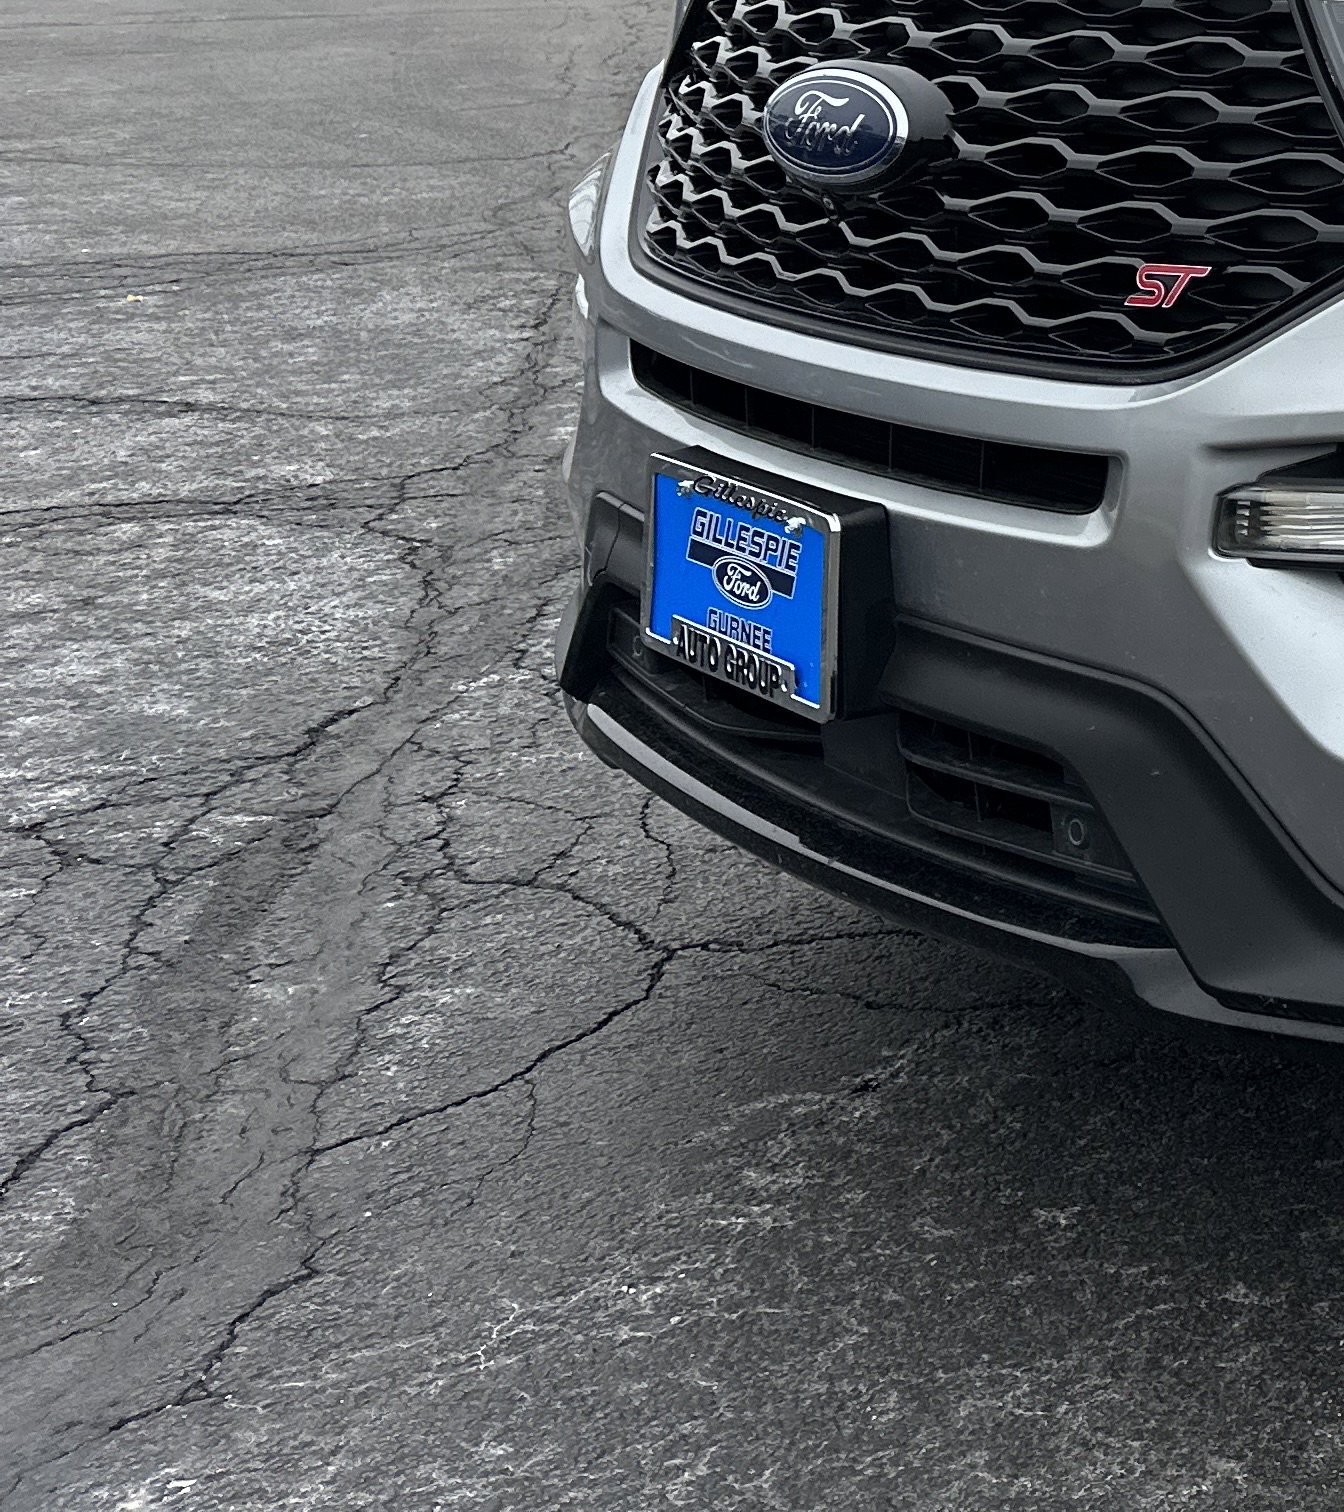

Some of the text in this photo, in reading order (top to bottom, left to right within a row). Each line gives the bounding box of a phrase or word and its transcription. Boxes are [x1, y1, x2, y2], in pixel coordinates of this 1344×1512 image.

[781, 88, 859, 155] Ford
[1123, 263, 1212, 309] ST
[693, 474, 789, 523] Gillespie
[690, 506, 802, 574] GILLESPIE
[723, 561, 762, 604] Ford
[706, 606, 773, 654] GURNEE
[676, 623, 784, 699] AUTO GROUP
